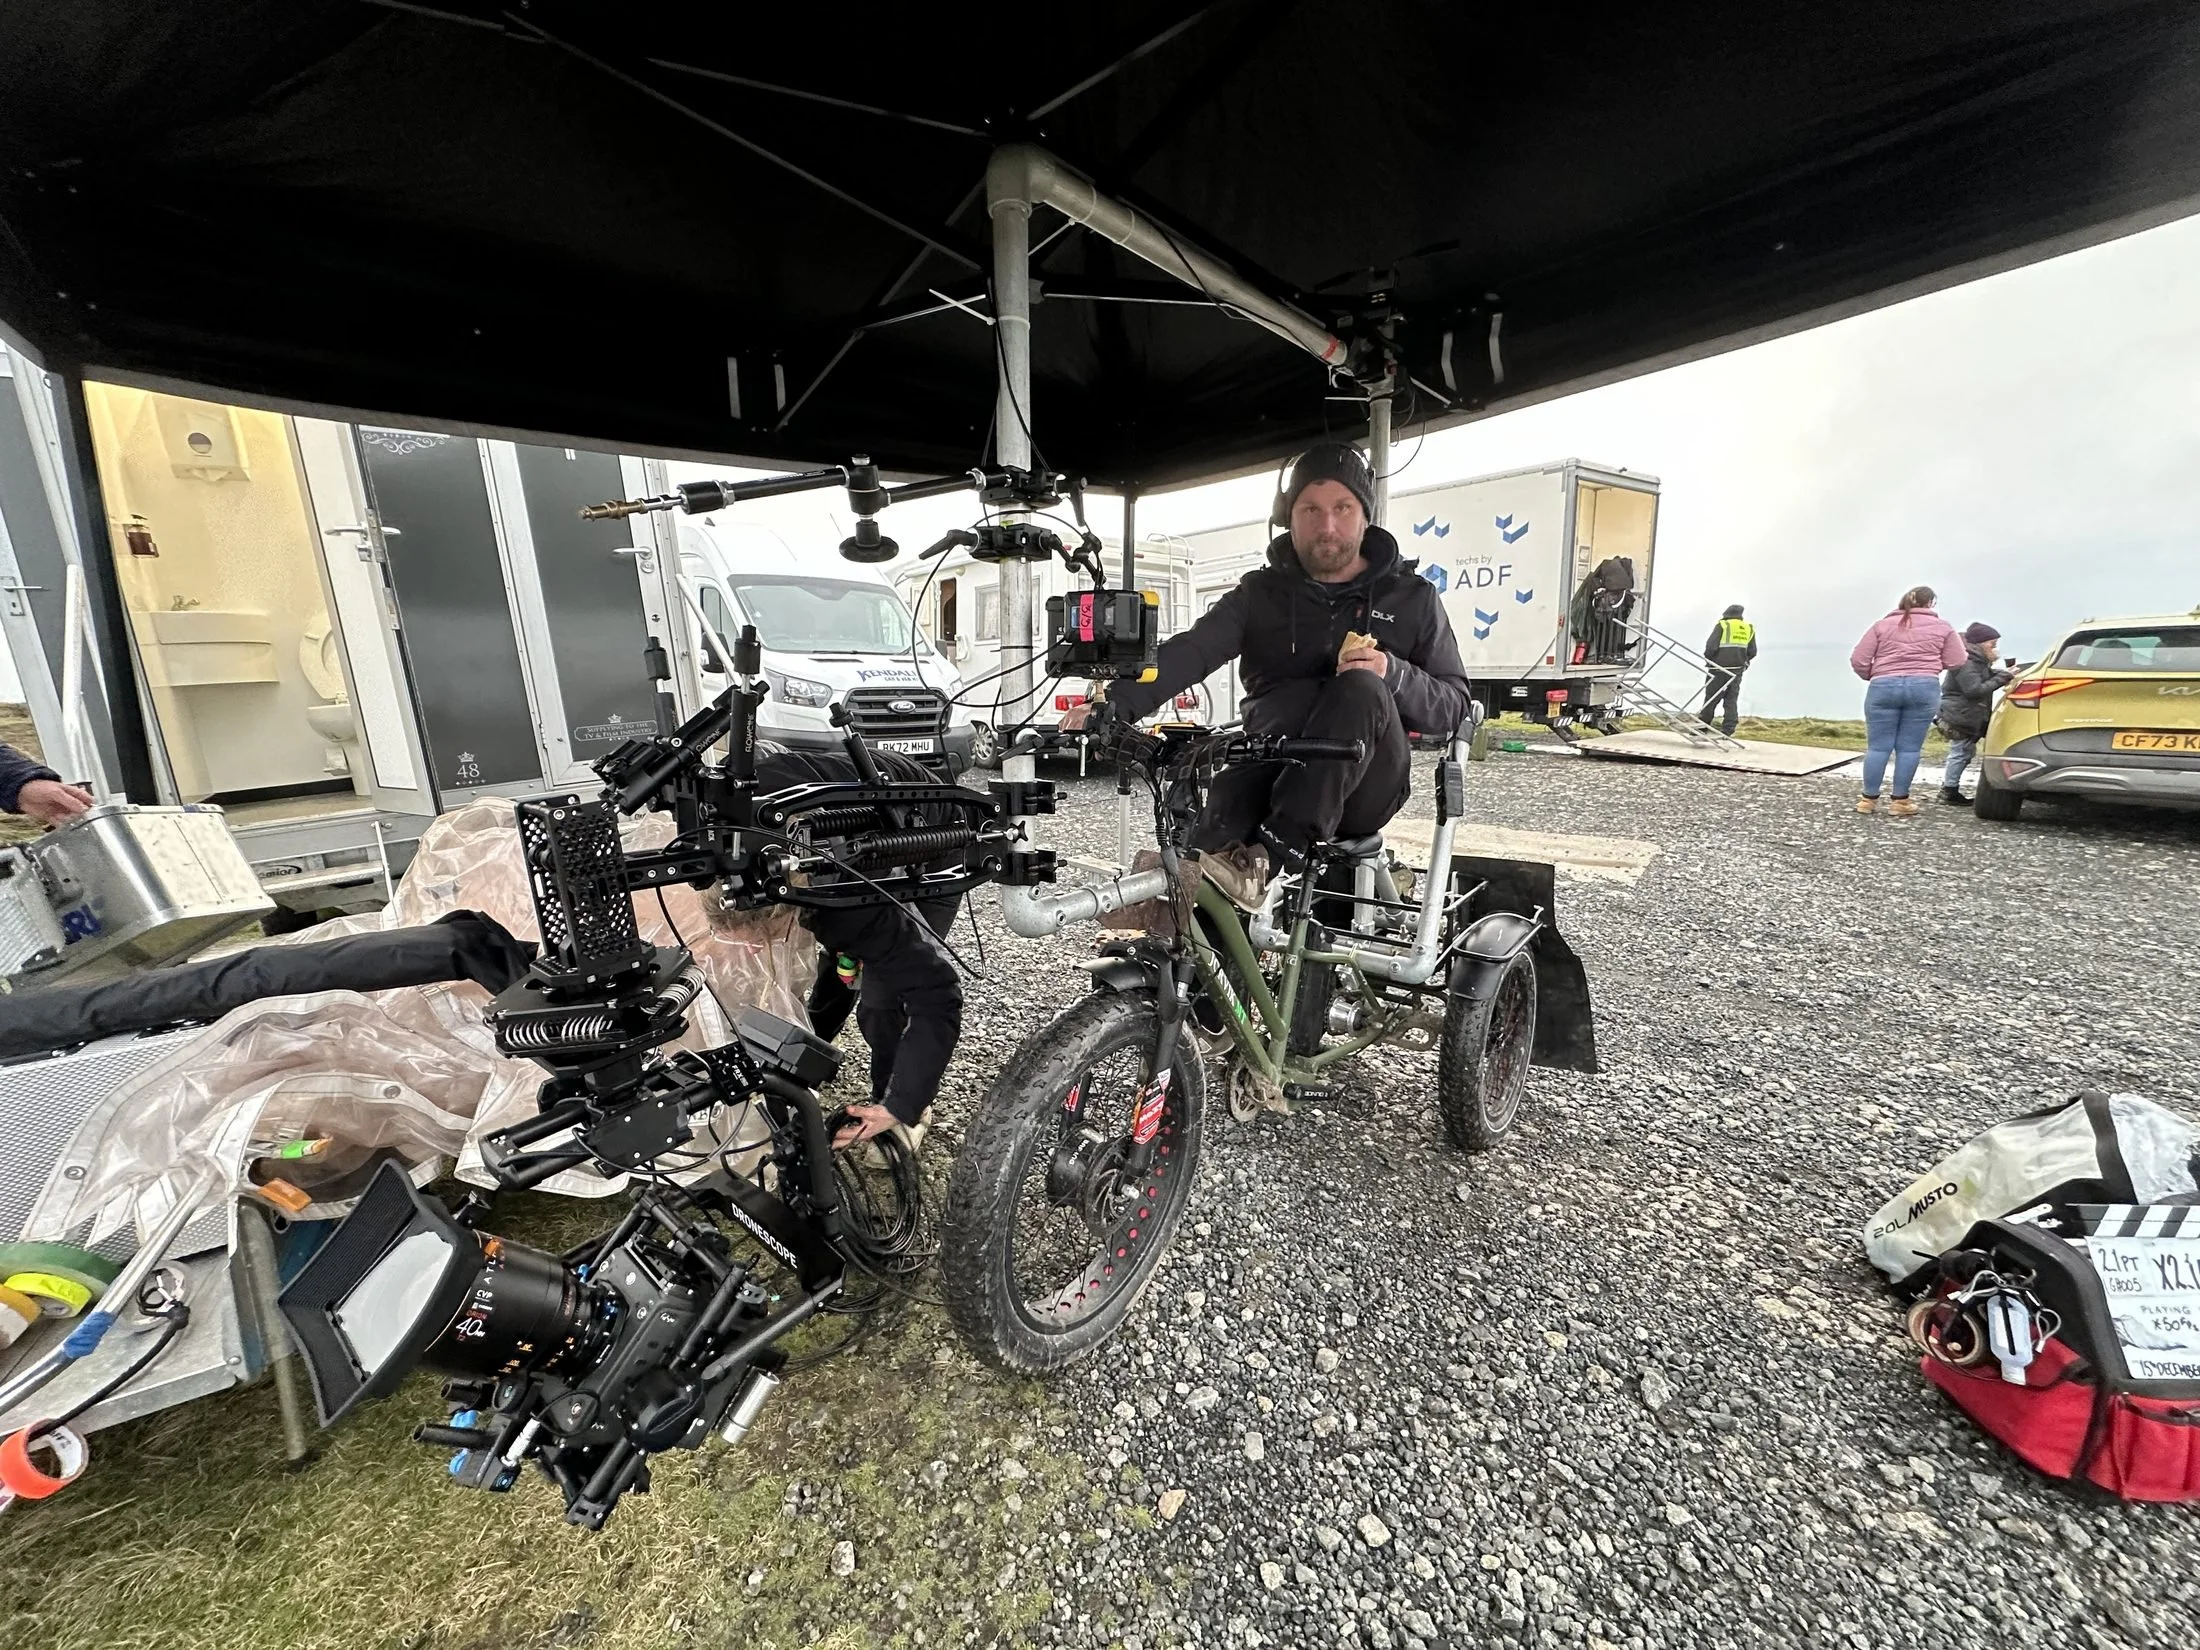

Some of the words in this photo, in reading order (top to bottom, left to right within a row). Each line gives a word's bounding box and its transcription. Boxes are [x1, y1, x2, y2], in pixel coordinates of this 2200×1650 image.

[1456, 555, 1479, 566] techs
[1481, 554, 1492, 565] by
[1455, 564, 1512, 590] ADF
[1371, 609, 1395, 623] DLX
[911, 741, 930, 753] MHU
[2121, 735, 2178, 748] CF73
[2184, 737, 2200, 750] K
[457, 763, 480, 778] 48
[1907, 1182, 1958, 1224] MUSTO
[731, 1202, 798, 1269] DRONESCOPE
[476, 1289, 493, 1299] CVP
[2140, 1304, 2191, 1315] PLAYING
